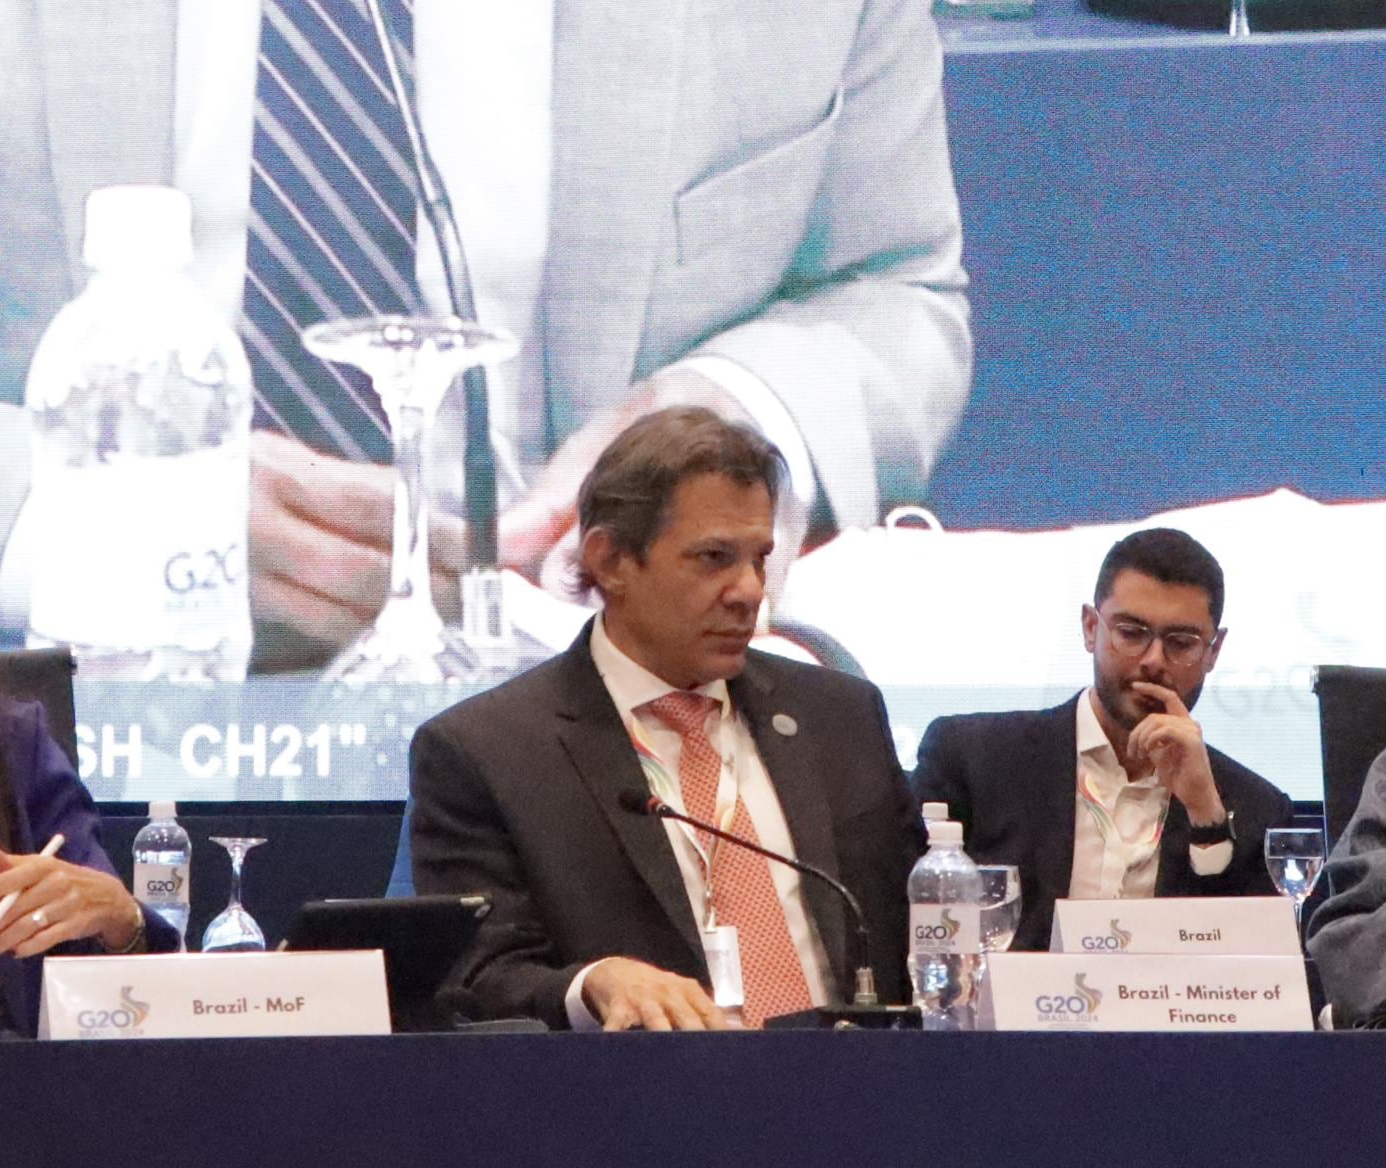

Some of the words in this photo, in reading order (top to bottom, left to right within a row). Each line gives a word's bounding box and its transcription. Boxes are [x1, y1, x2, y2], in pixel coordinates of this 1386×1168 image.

[179, 723, 367, 779] CH21"
[147, 880, 175, 892] G20
[915, 925, 947, 939] G20
[1178, 928, 1222, 942] Brazil
[1081, 935, 1119, 950] G20
[1118, 984, 1169, 1001] Brazil
[1186, 985, 1258, 1001] Minister
[1263, 984, 1281, 1001] of
[192, 997, 249, 1016] Brazil
[266, 996, 305, 1014] MoF
[1035, 995, 1086, 1014] G20
[77, 1009, 132, 1029] G20
[1168, 1008, 1237, 1024] Finance
